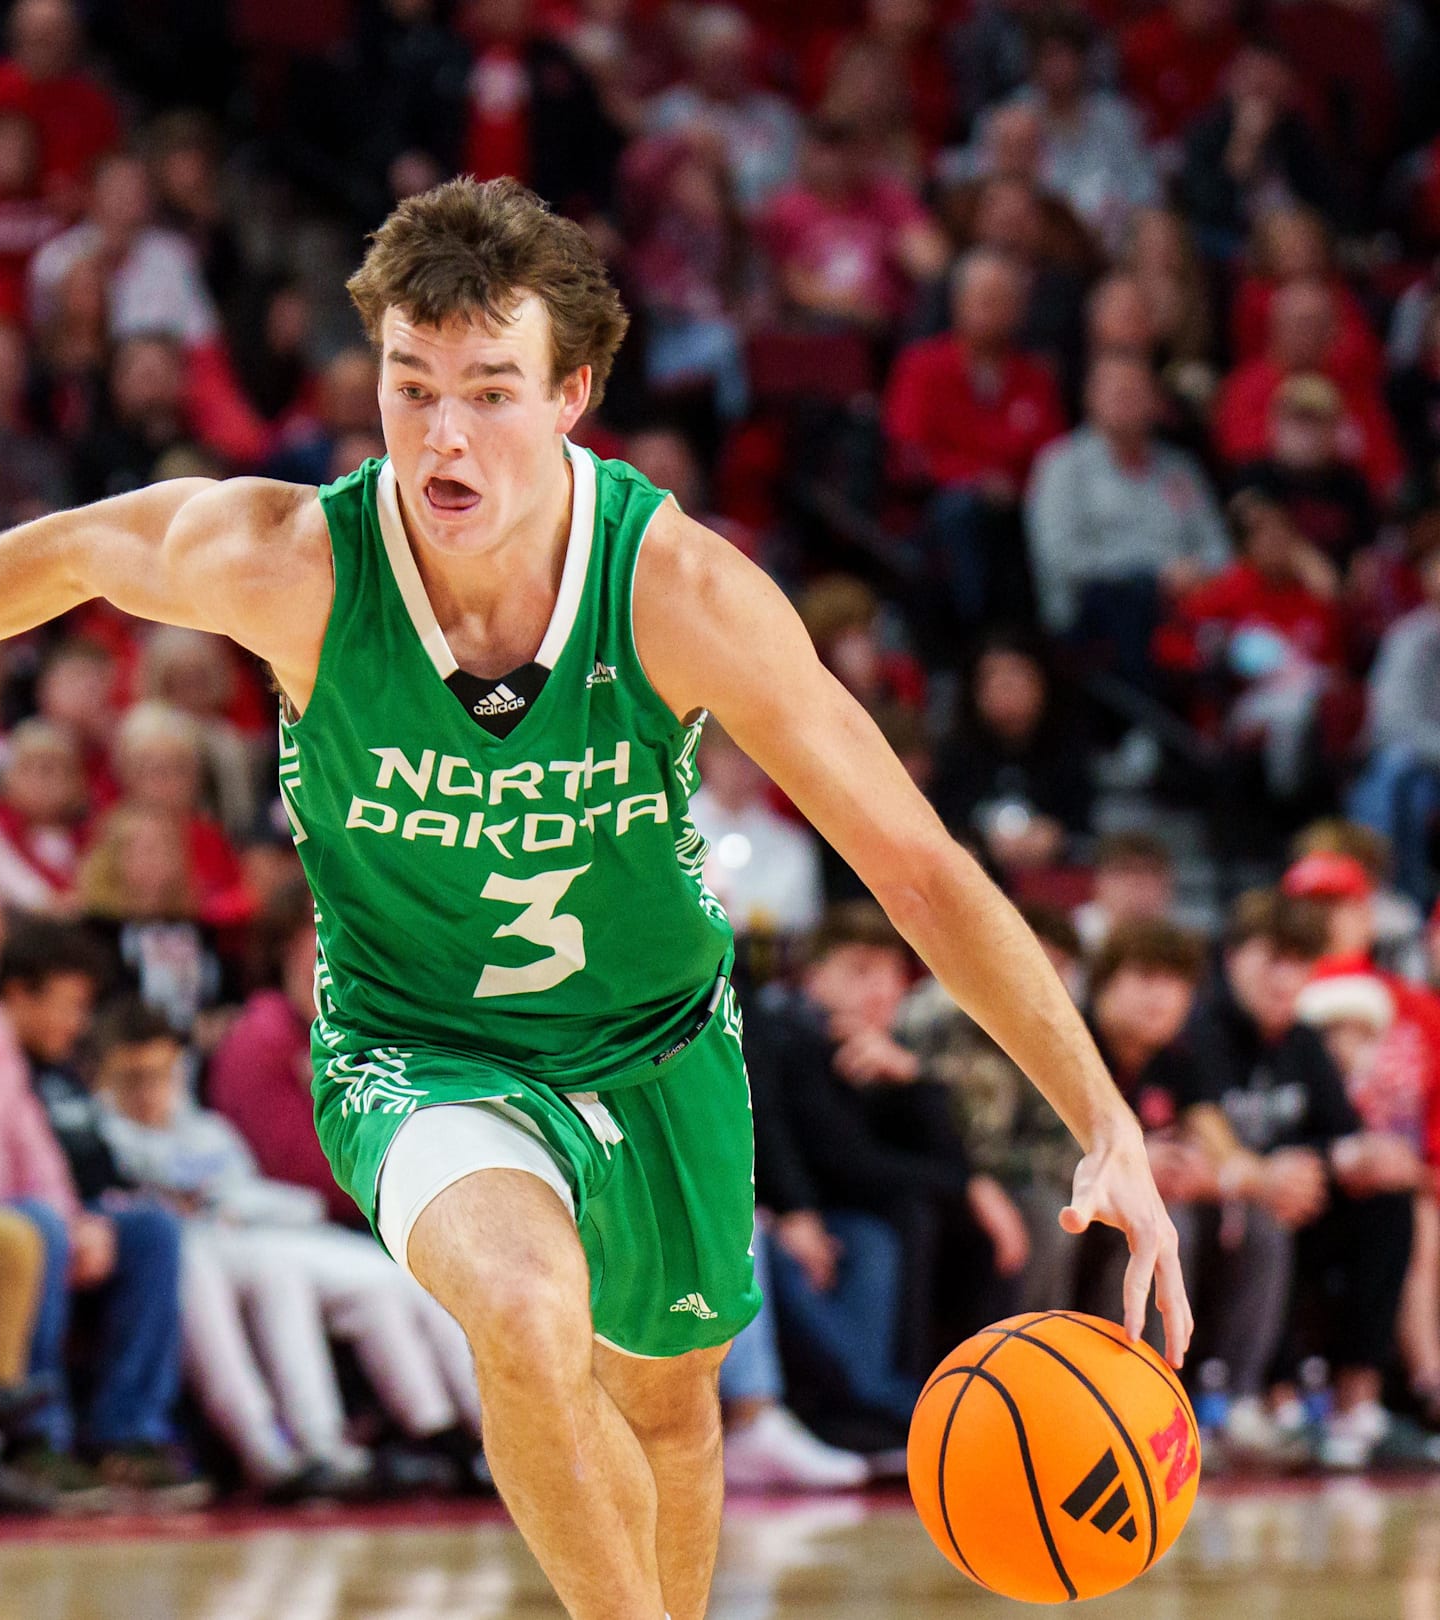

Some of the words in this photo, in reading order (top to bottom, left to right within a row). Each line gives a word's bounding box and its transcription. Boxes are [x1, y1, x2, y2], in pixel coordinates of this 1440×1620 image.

[473, 696, 526, 716] adidas
[367, 741, 630, 806] NORTH
[345, 790, 669, 860] DAKOTA
[472, 861, 593, 999] 3
[670, 1302, 718, 1320] adidas
[1148, 1406, 1198, 1503] N
